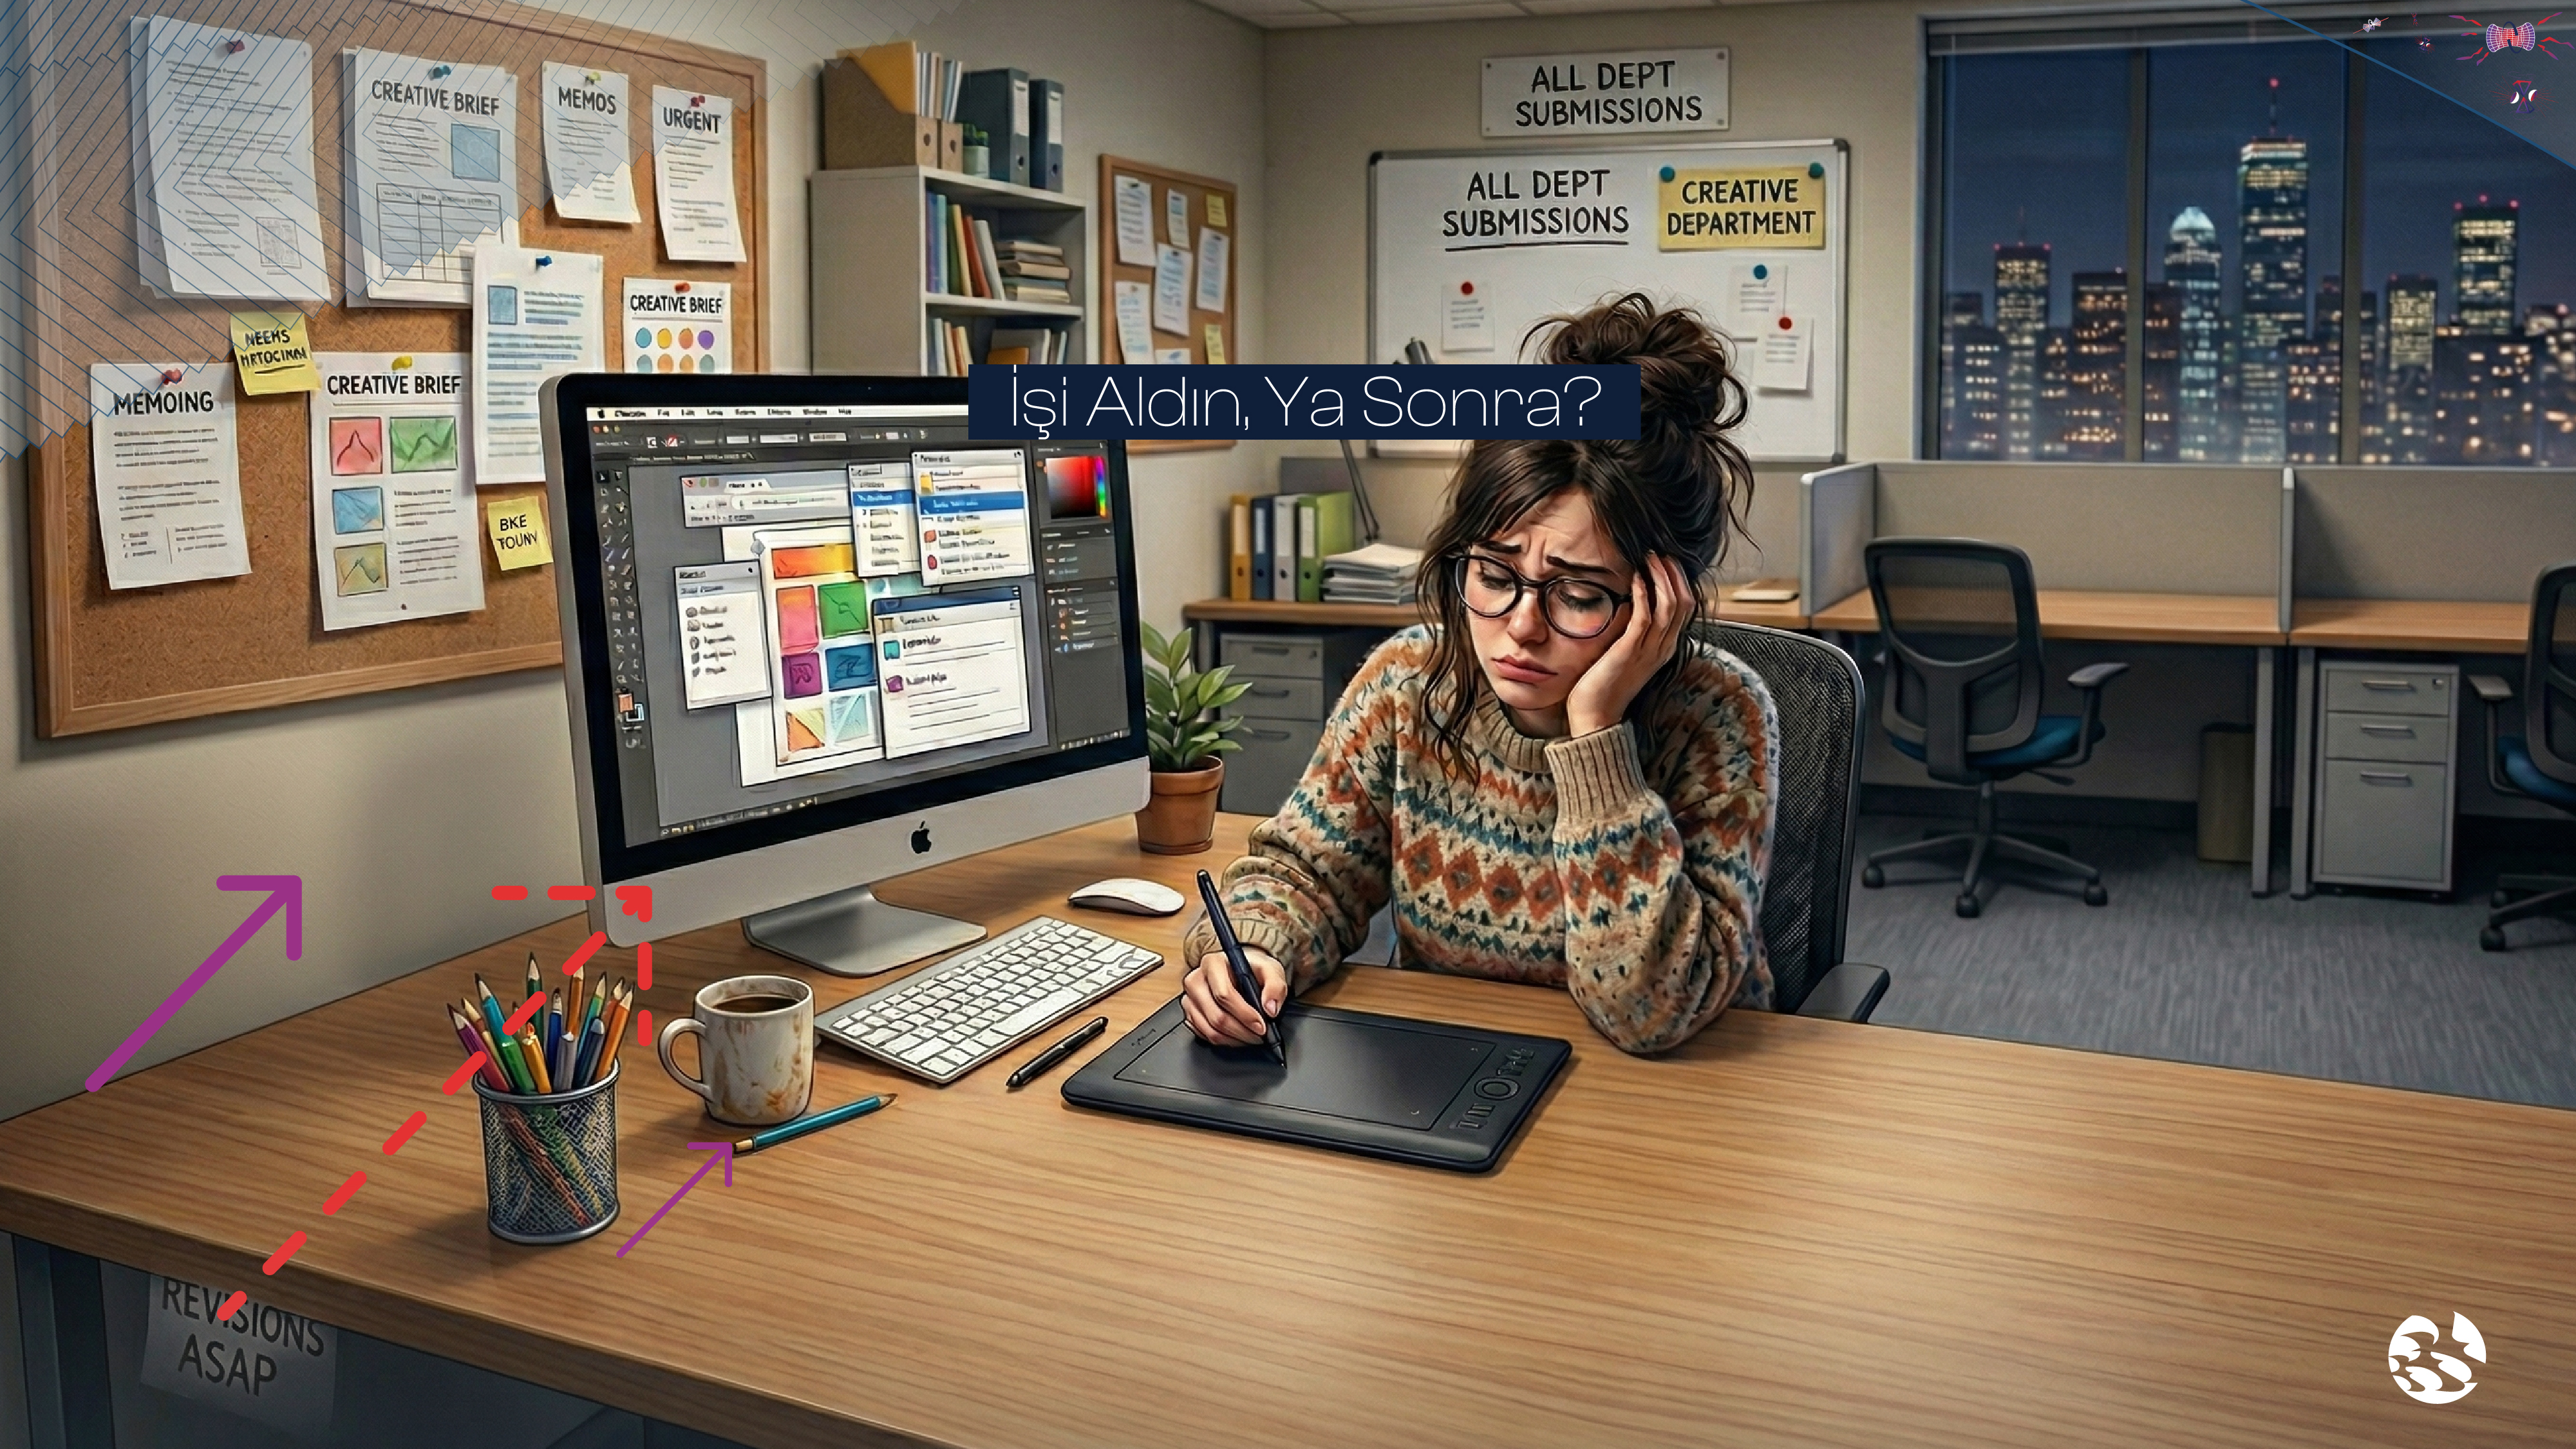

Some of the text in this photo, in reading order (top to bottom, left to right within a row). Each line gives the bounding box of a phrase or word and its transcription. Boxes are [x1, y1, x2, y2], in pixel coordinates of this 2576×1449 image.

[1531, 61, 1675, 93] ALL DEPT
[371, 79, 500, 116] CREATIVE BRIEF
[558, 86, 616, 115] MEMOS
[1515, 96, 1702, 127] SUBMISSIONS
[663, 106, 721, 133] URGENT
[1467, 170, 1610, 201] ALL DEPT
[1682, 178, 1799, 205] CREATIVE
[1442, 206, 1629, 238] SUBMISSIONS
[1667, 210, 1816, 237] DEPARTMENT
[630, 294, 722, 313] CREATIVE BRIEF
[327, 375, 461, 395] CREATIVE BRIEF
[114, 391, 214, 415] MEMOING
[500, 514, 527, 531] BKE
[178, 1334, 277, 1397] ASAP
